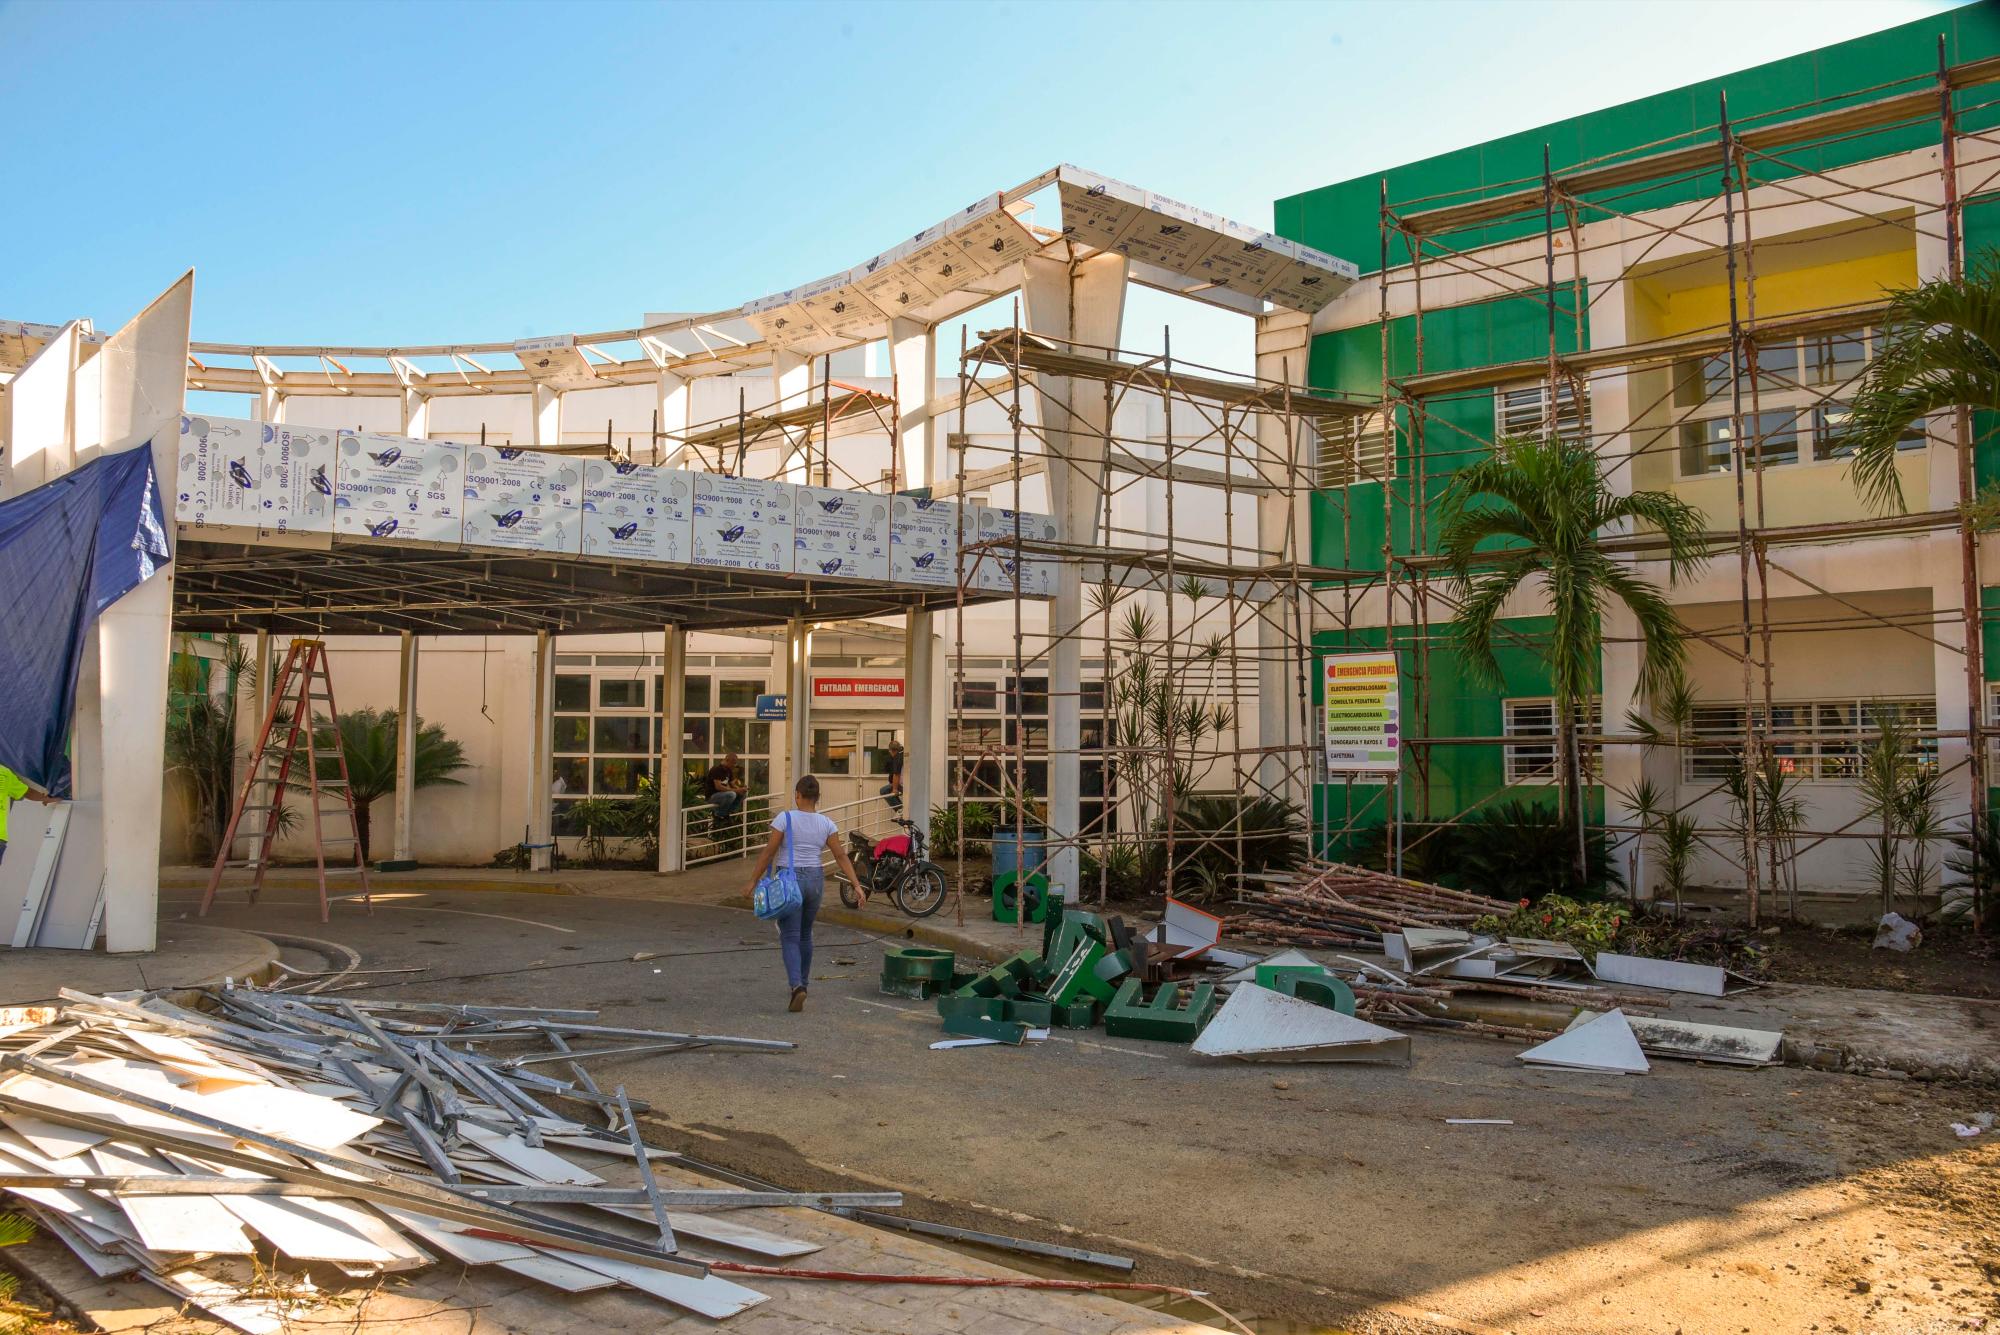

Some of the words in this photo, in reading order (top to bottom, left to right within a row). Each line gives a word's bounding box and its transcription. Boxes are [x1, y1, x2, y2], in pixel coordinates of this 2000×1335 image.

[466, 475, 521, 487] ISO9001:2008
[549, 484, 567, 492] SGS
[427, 492, 446, 500] SGS
[662, 497, 678, 505] SGS
[196, 512, 204, 528] SGS
[278, 518, 286, 535] SGS
[693, 557, 741, 567] ISO9001:2008
[1337, 666, 1366, 677] EMERGENCIA
[820, 684, 851, 692] ENTRADA
[855, 684, 899, 692] EMERGENCIA
